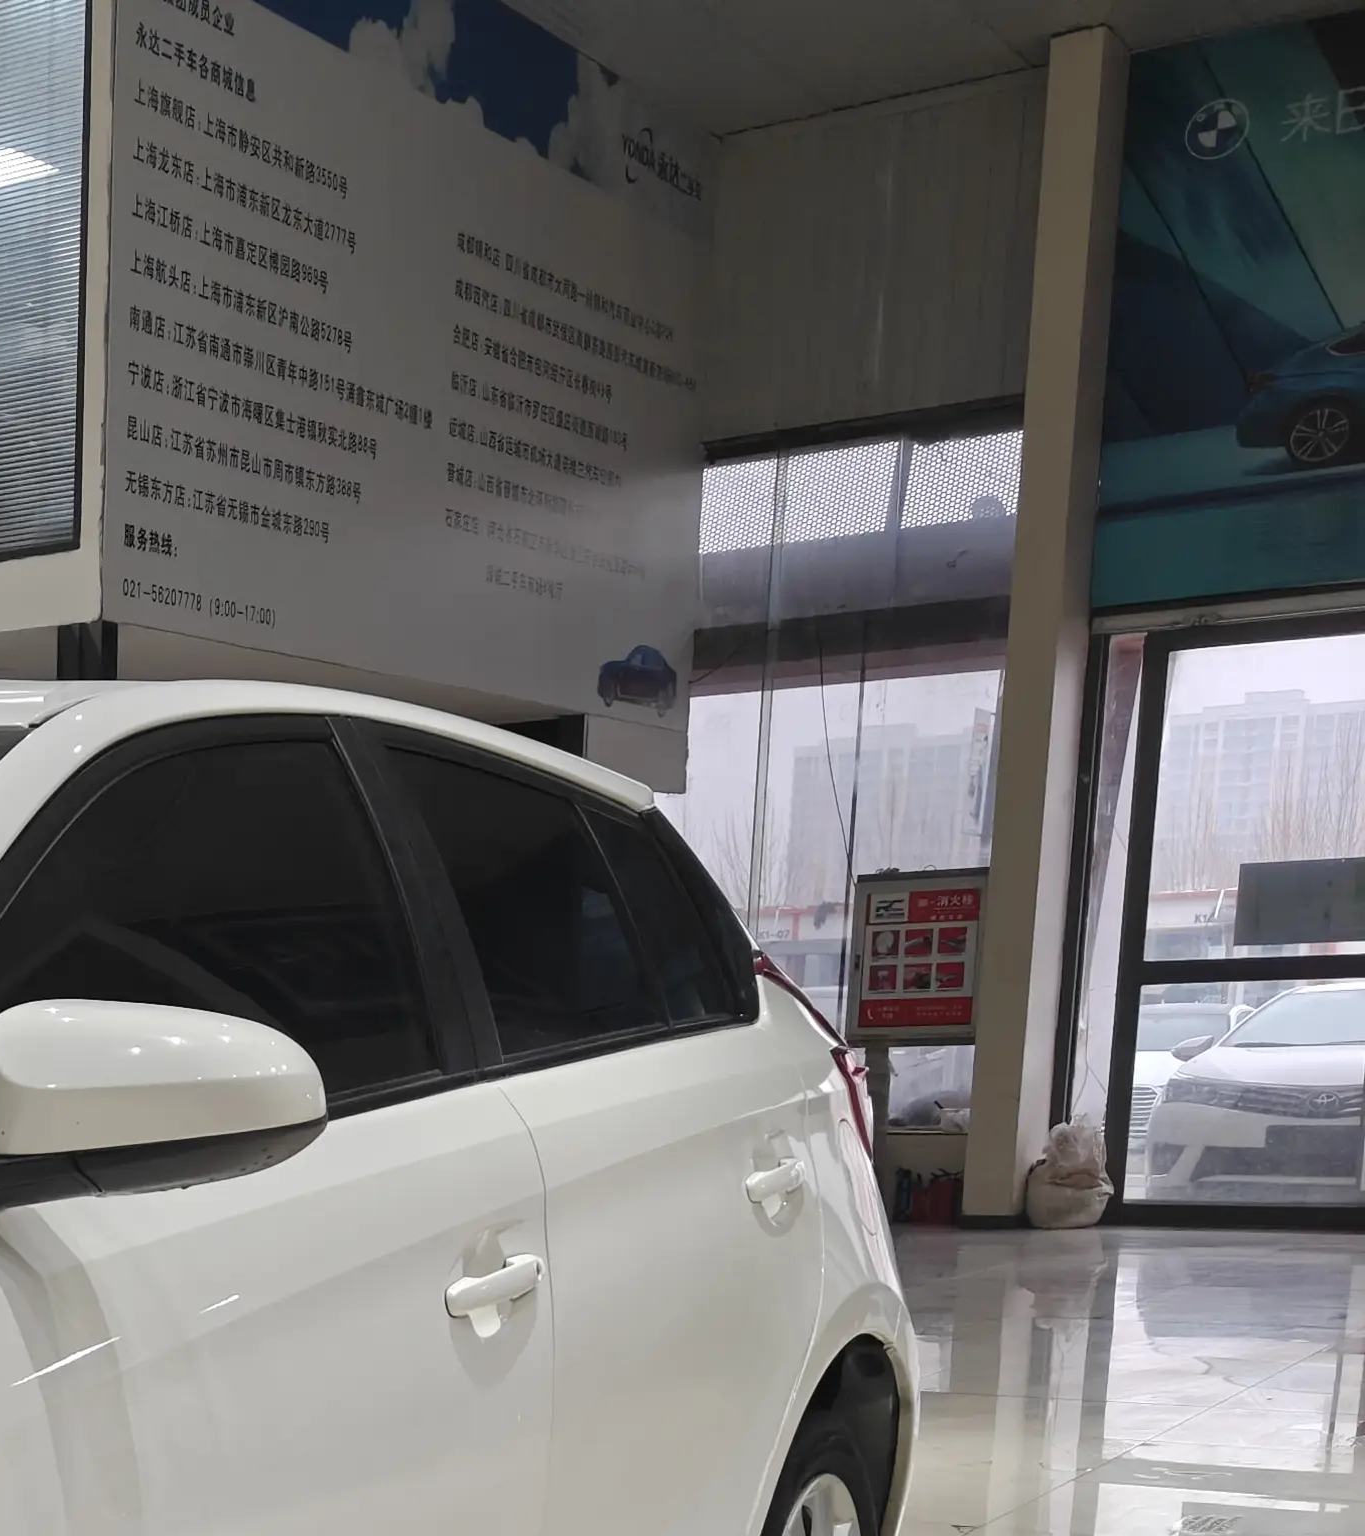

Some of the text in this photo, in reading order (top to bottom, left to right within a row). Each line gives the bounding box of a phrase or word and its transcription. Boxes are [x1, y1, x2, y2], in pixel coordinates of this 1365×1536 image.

[135, 22, 256, 103] 永达二手车各商城信息
[122, 578, 202, 613] 021-56207778
